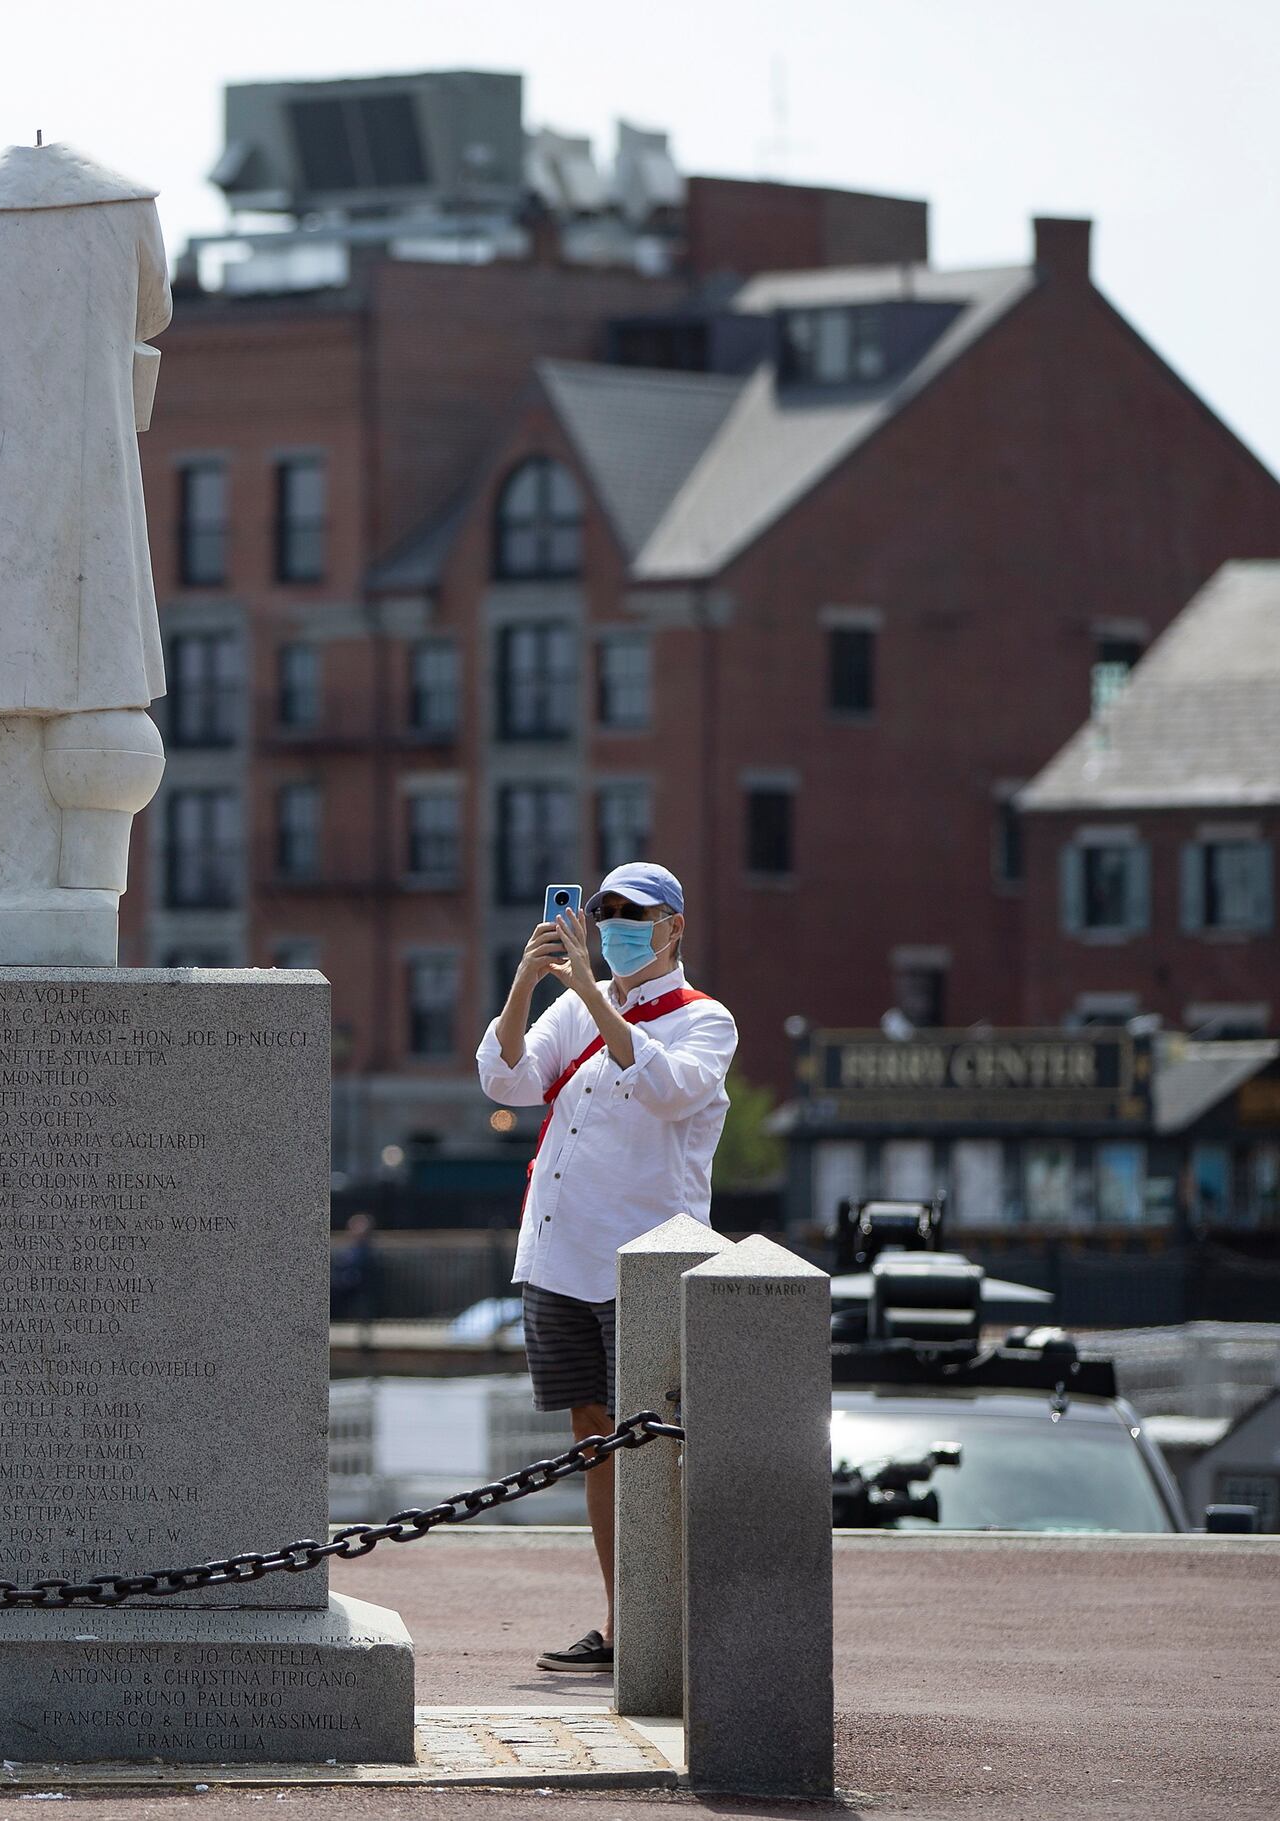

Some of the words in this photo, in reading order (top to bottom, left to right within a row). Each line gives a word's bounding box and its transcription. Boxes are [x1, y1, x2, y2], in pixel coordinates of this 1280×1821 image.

[35, 989, 90, 1003] VOLPE
[44, 1008, 130, 1024] LANGONE
[181, 1031, 216, 1046] JOE
[64, 1051, 167, 1066] STIVALETTA
[3, 1070, 89, 1085] MONTILIO
[70, 1092, 117, 1106] SONS
[21, 1112, 95, 1127] SOCIETY
[47, 1133, 102, 1147] MARIA
[111, 1133, 207, 1148] GAGLIARDI
[20, 1174, 98, 1189] COLONIA
[107, 1174, 177, 1189] RIESINA
[40, 1194, 150, 1210] SOMERVILLE
[89, 1216, 127, 1230] MEN
[171, 1216, 236, 1231] WOMEN
[74, 1236, 151, 1251] SOCIETY
[73, 1256, 135, 1272] BRUNO
[3, 1277, 87, 1292] GUBITOSI
[96, 1277, 159, 1293] FAMILY
[712, 1283, 742, 1295] TONY
[55, 1299, 141, 1314] CARDONE
[0, 1318, 55, 1333] MARIA
[64, 1319, 120, 1335] SULLO
[112, 1361, 216, 1377] IACOVIELLO
[83, 1403, 145, 1418] FAMILY
[82, 1424, 145, 1439] FAMILY
[23, 1444, 74, 1458] KAITZ
[85, 1445, 147, 1460] FAMILY
[56, 1465, 134, 1481] FERULLO
[3, 1505, 98, 1522] SETTIPANE
[10, 1528, 55, 1543] POST
[62, 1550, 120, 1564] FAMILY
[84, 1648, 161, 1664] VINCENT
[173, 1652, 182, 1663] &
[195, 1650, 219, 1666] JO
[231, 1650, 324, 1665] CANTELLA
[49, 1668, 132, 1684] ANTONIO
[143, 1672, 153, 1684] &
[164, 1669, 261, 1686] CHRISTINA
[272, 1671, 357, 1687] FIRICANO
[123, 1691, 186, 1706] BRUNO
[198, 1691, 282, 1708] PALUMBO
[43, 1711, 153, 1727] FRANCESCO
[184, 1712, 239, 1729] ELENA
[251, 1714, 362, 1730] MASSIMILLA
[137, 1733, 196, 1748] FRANK
[207, 1734, 265, 1750] GULLA
